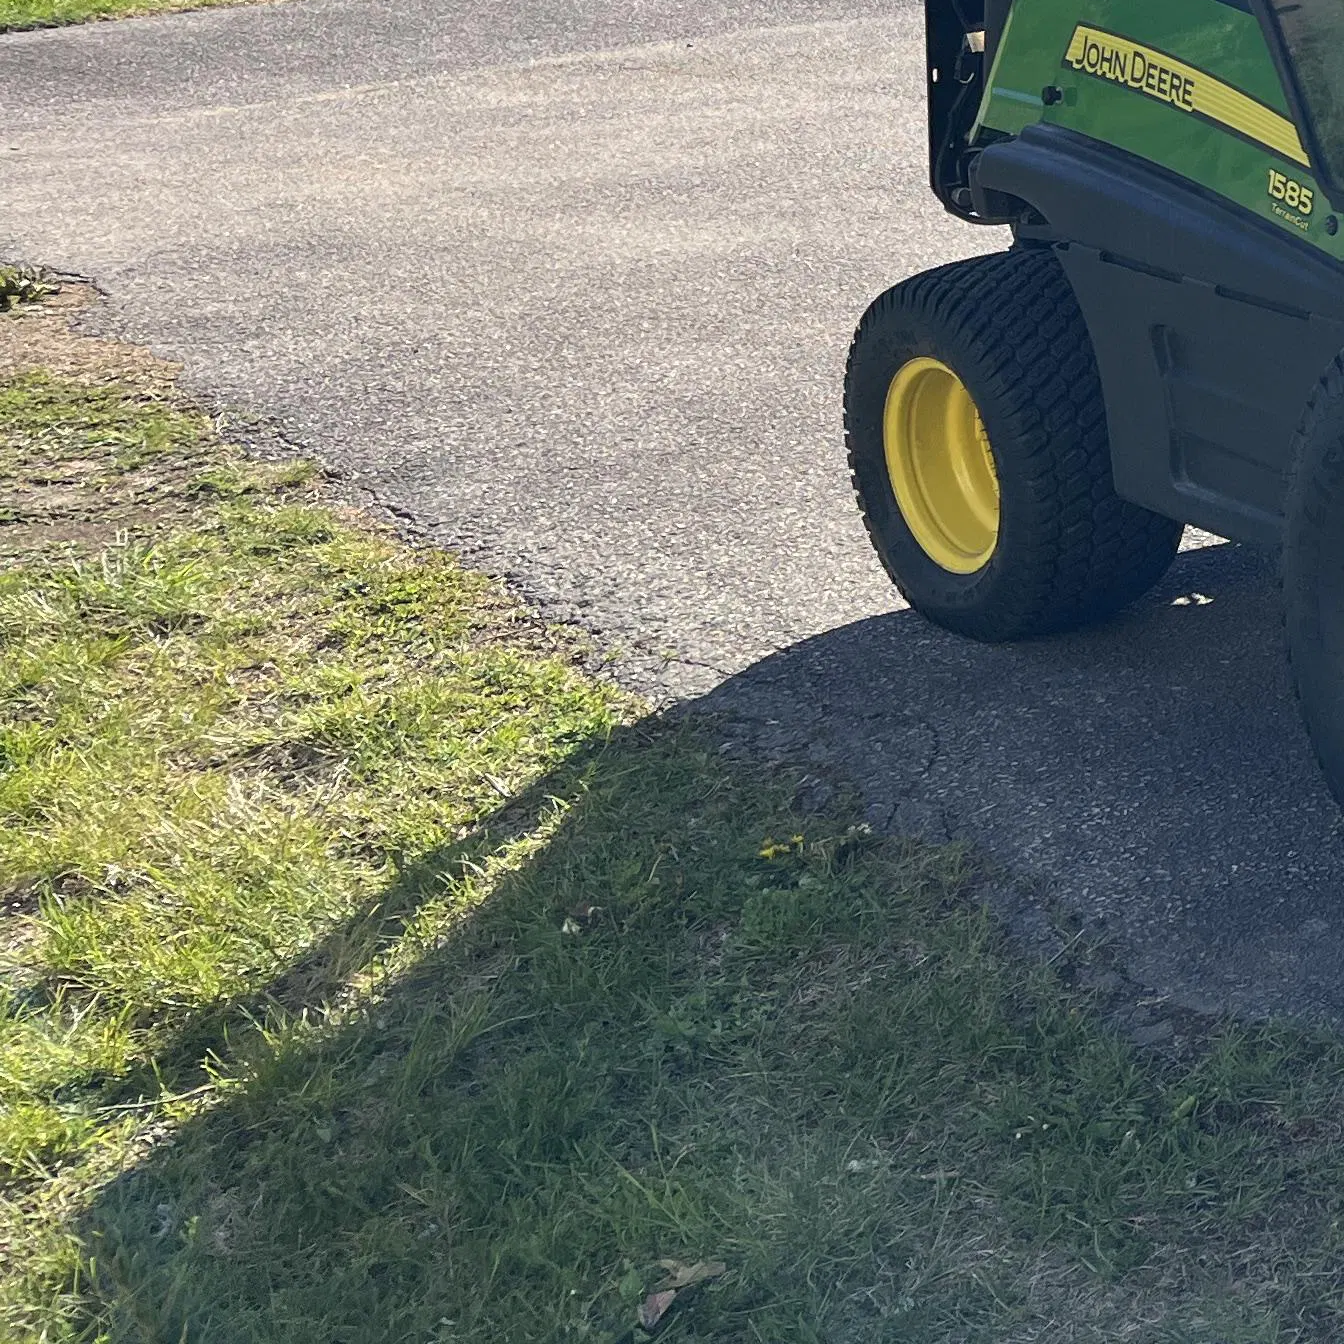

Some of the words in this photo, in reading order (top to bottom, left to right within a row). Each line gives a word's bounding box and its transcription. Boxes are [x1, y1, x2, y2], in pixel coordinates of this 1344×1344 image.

[1075, 35, 1128, 79] JOHN
[1131, 51, 1195, 107] DEERE
[1268, 169, 1314, 215] 1585
[1271, 202, 1310, 232] TerrainCut
